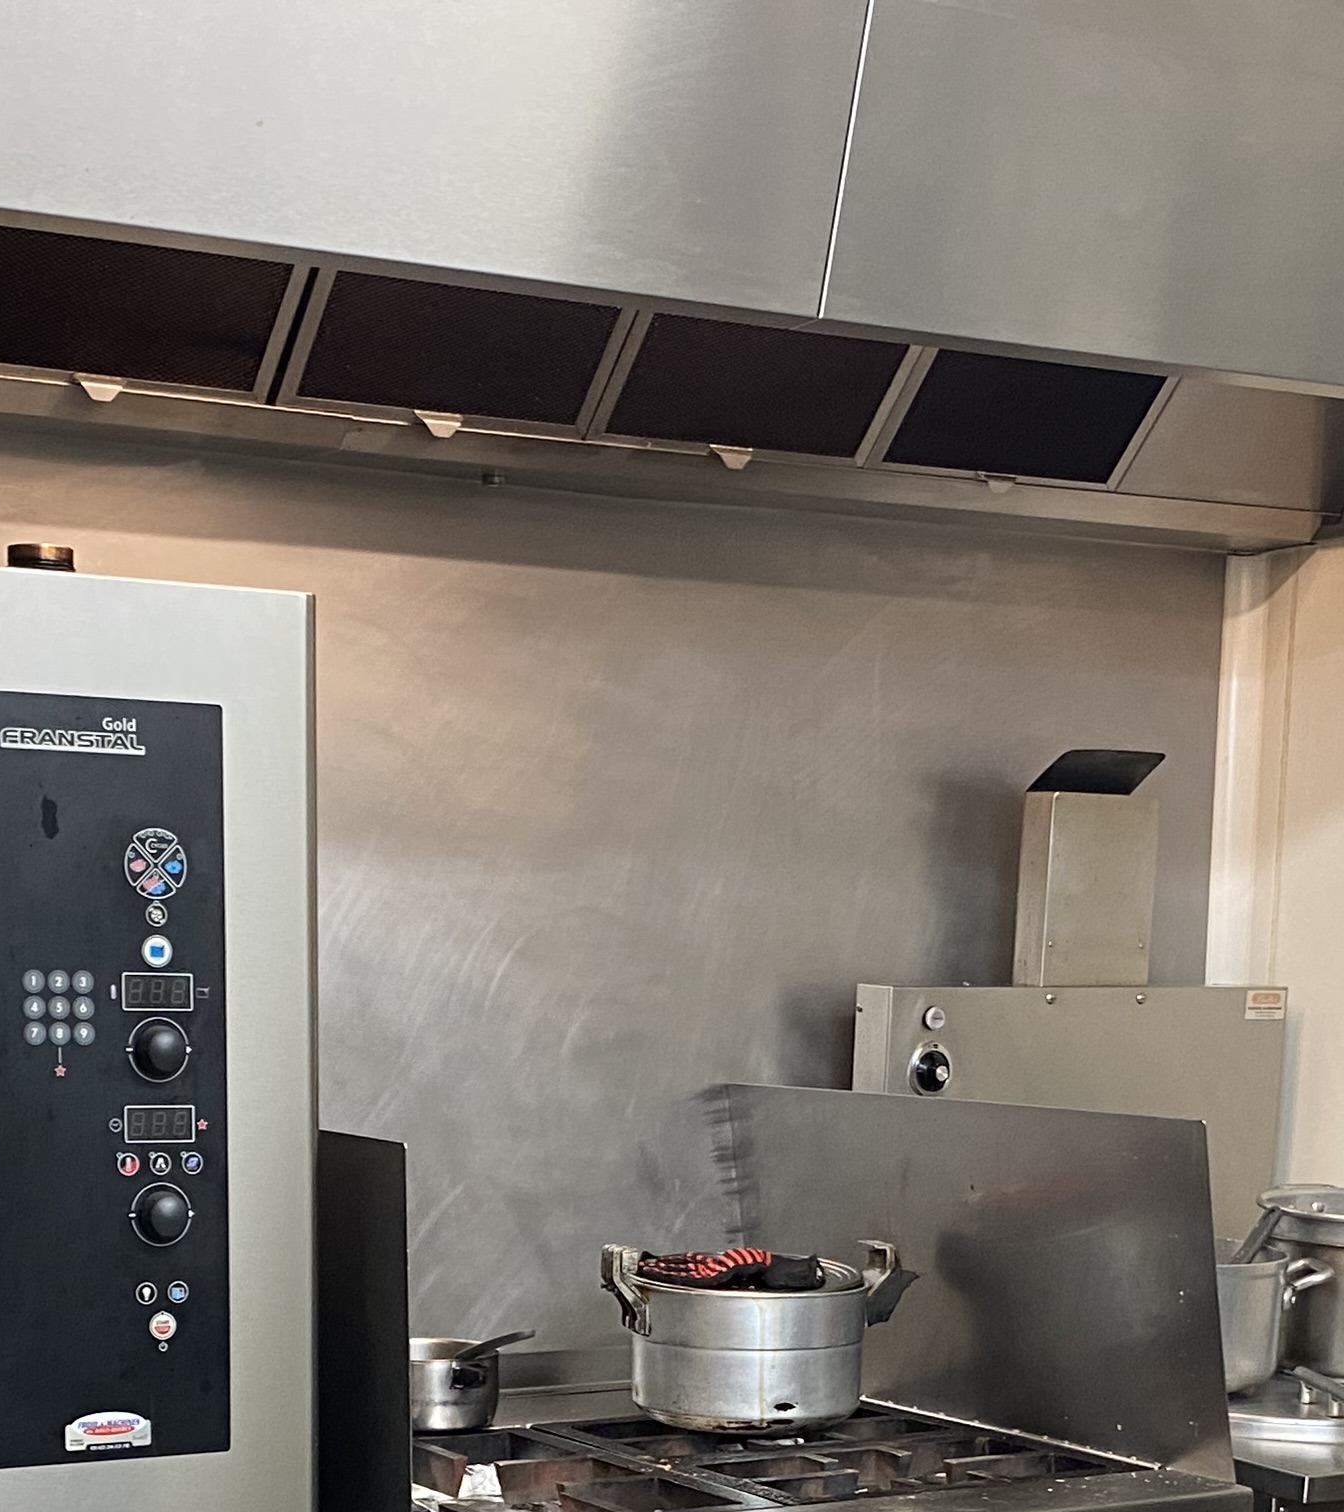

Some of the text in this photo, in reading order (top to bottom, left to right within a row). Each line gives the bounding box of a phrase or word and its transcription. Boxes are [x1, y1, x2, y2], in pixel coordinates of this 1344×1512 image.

[102, 717, 137, 732] Gold
[0, 727, 146, 755] FRANSTAL
[31, 975, 87, 987] 1 2 3
[30, 1002, 88, 1013] 4 5 6
[31, 1027, 88, 1039] 7 8 9
